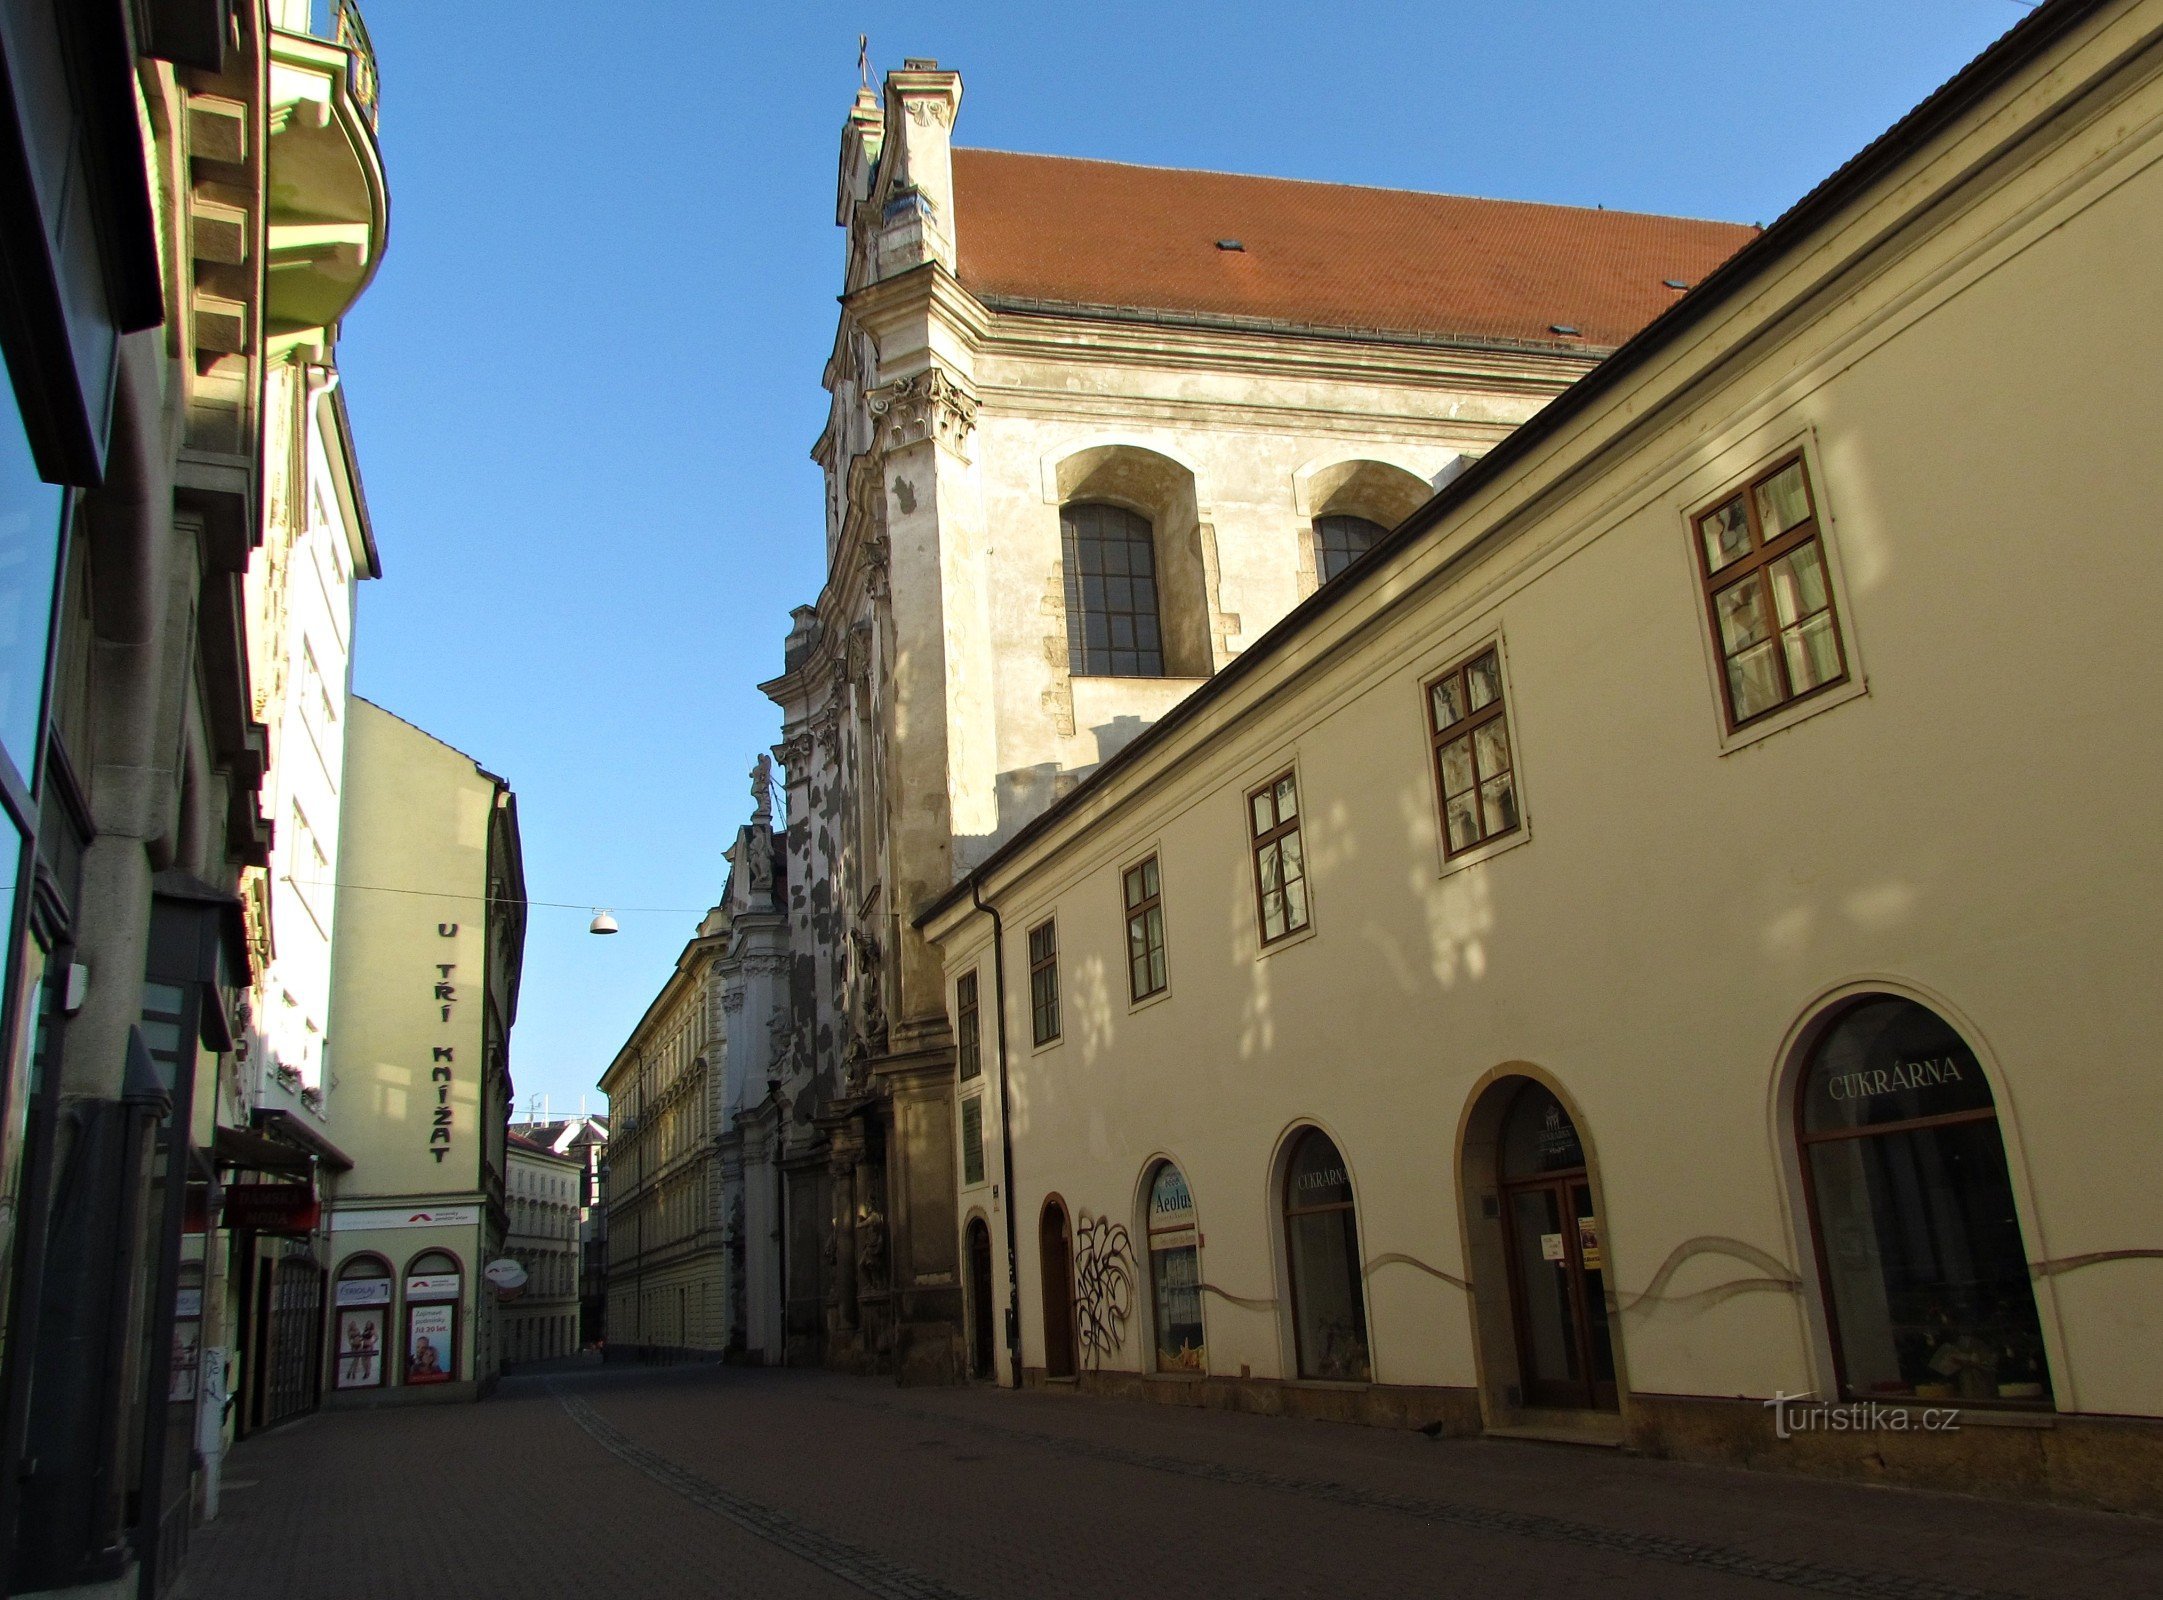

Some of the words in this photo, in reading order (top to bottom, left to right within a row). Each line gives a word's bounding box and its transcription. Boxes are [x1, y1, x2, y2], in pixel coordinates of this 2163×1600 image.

[438, 923, 458, 938] U
[434, 964, 458, 1022] TŘÍ
[1829, 1056, 1963, 1101] CUKRÁRNA
[430, 1046, 453, 1163] KNÍŽAT
[1155, 1188, 1193, 1214] Aeolus
